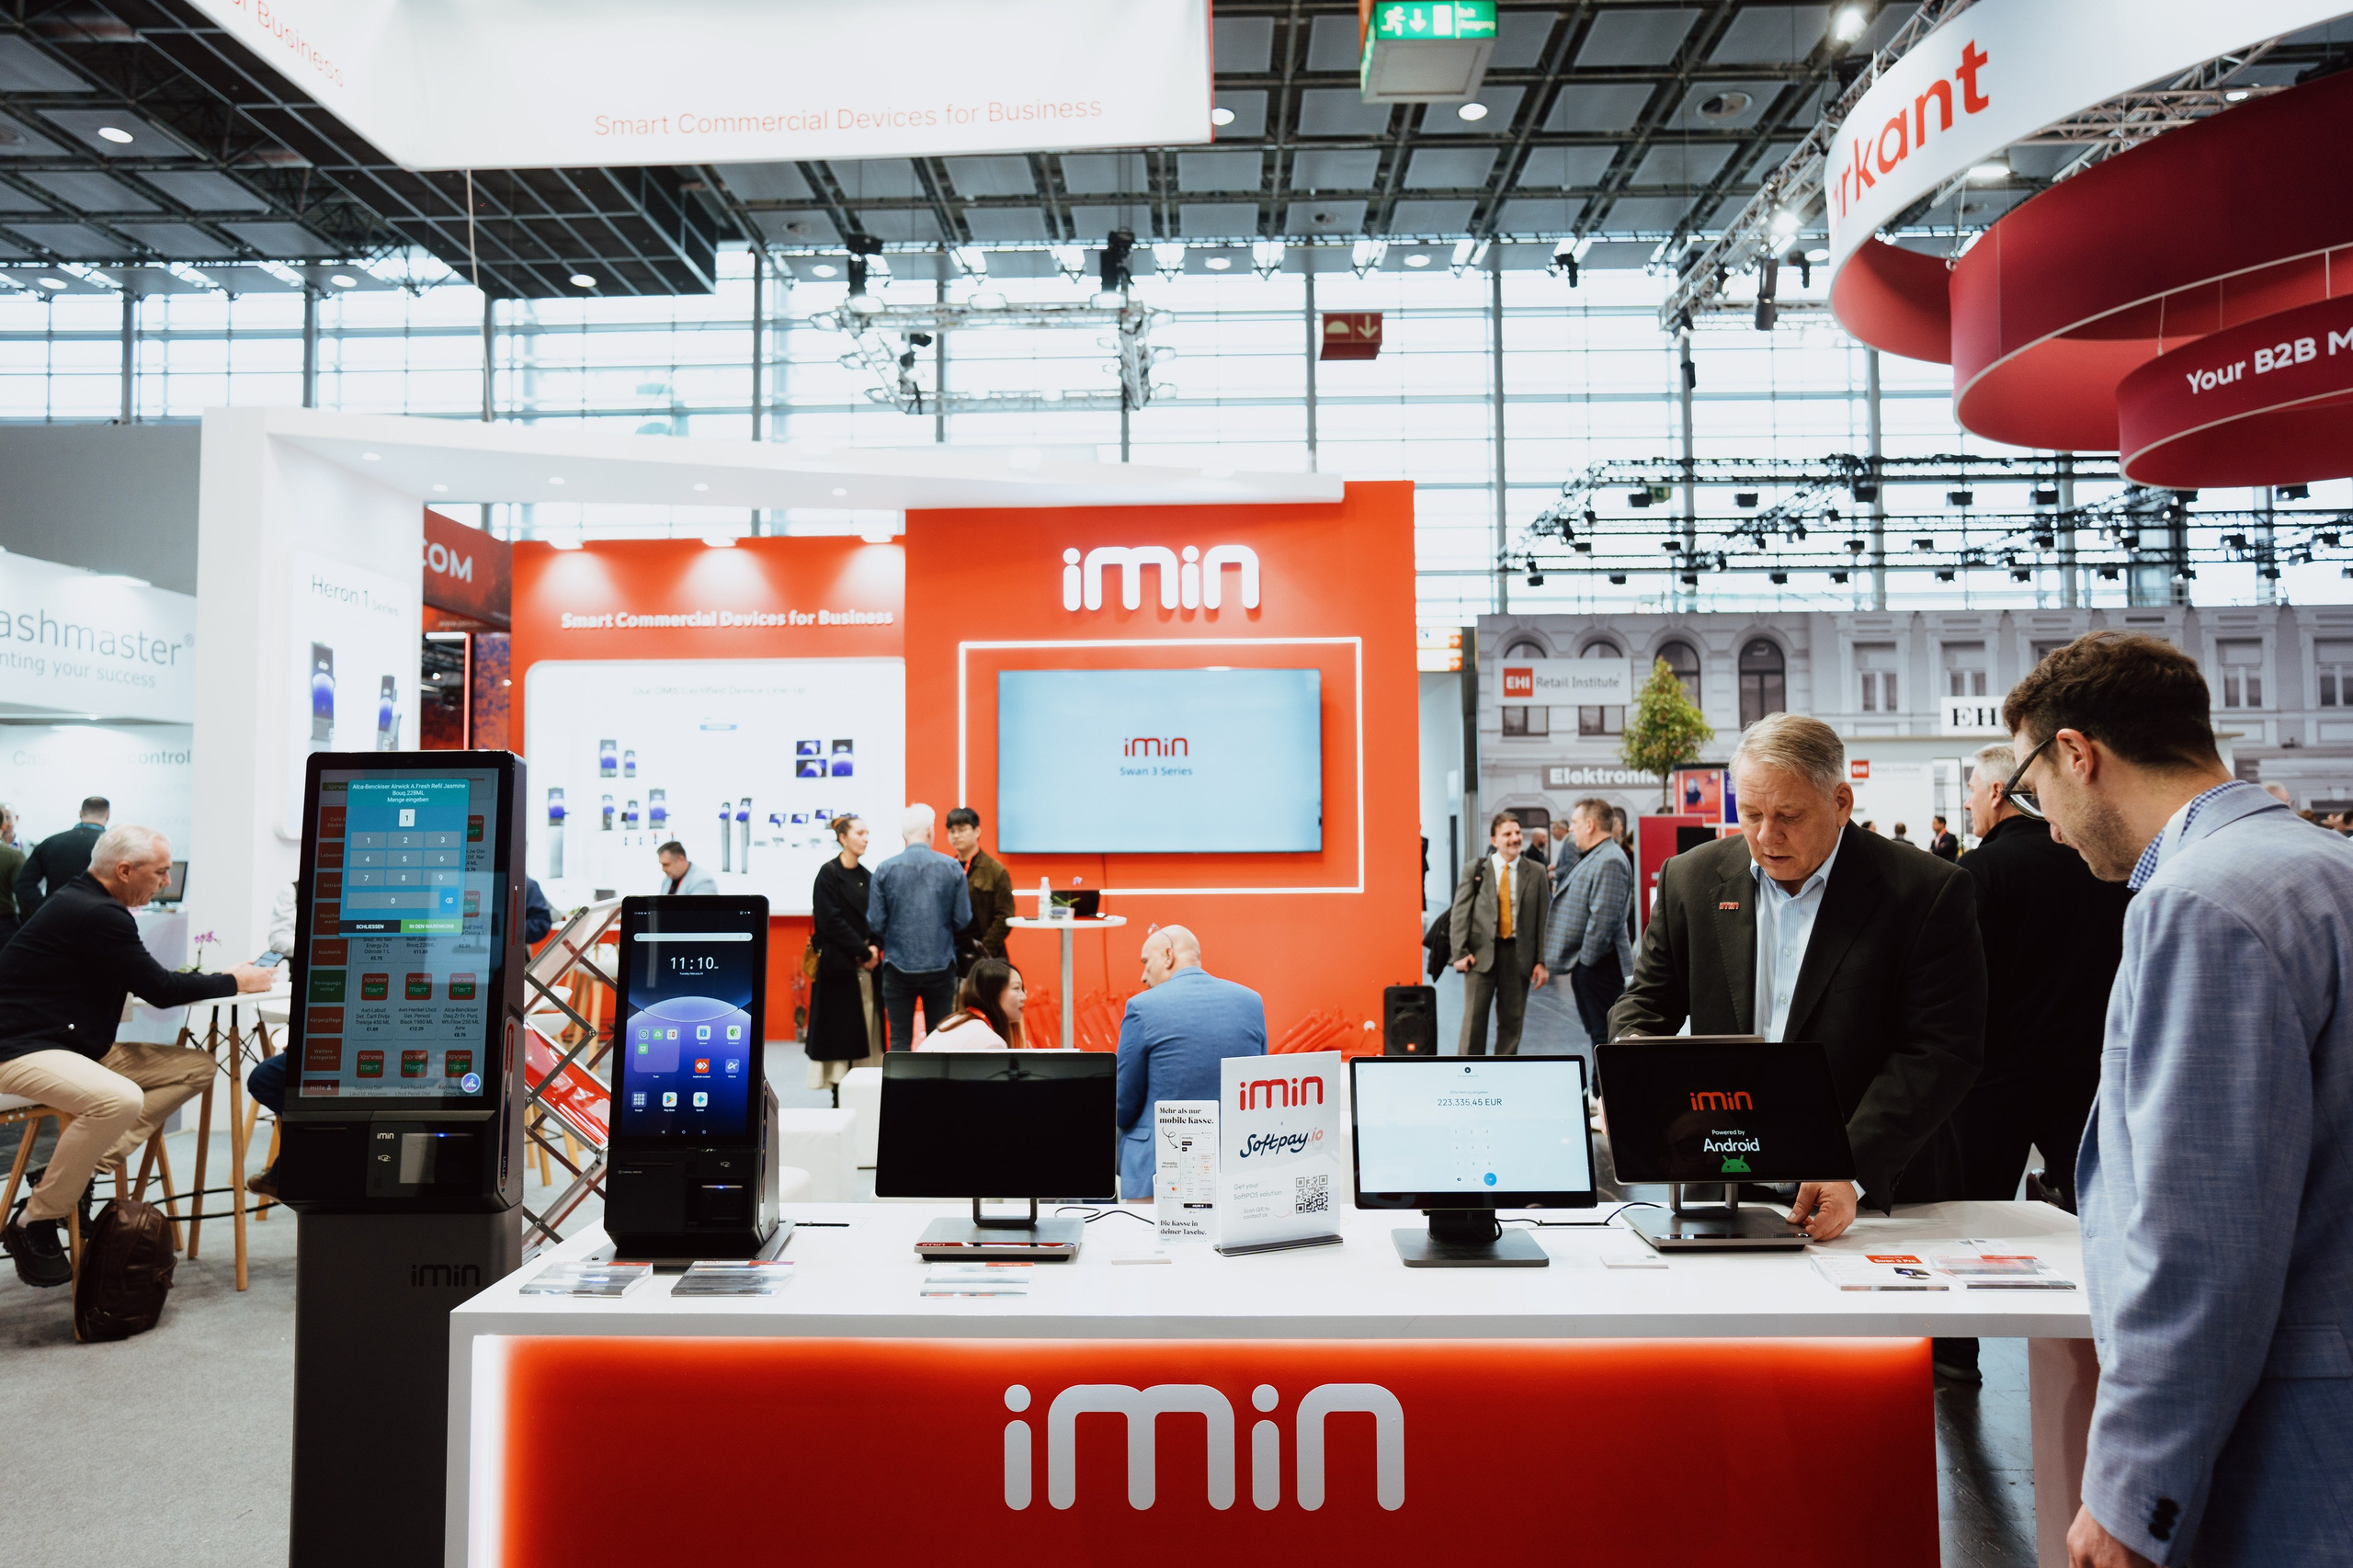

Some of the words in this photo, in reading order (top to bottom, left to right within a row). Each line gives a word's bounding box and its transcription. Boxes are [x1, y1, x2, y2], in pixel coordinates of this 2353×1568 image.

[257, 0, 344, 87] Business
[595, 114, 669, 136] Smart
[677, 110, 829, 134] Commercial
[837, 106, 938, 130] Devices
[946, 103, 981, 124] for
[988, 99, 1103, 122] Business
[2186, 360, 2246, 394] Your
[2254, 336, 2317, 374] B2B
[423, 538, 472, 584] OM
[312, 574, 358, 605] Heron
[363, 590, 369, 608] 1
[1063, 544, 1260, 612] imin
[562, 612, 613, 630] Smart
[616, 610, 717, 629] Commercial
[720, 609, 786, 627] Devices
[789, 609, 815, 626] for
[818, 609, 893, 627] Business
[52, 660, 90, 677] your
[97, 666, 156, 688] success
[1506, 676, 1530, 689] EHI
[1536, 676, 1569, 688] Retail
[1573, 676, 1620, 688] Institute
[1124, 736, 1188, 757] imin
[1120, 767, 1149, 776] Swan
[1152, 767, 1158, 776] 3
[1161, 766, 1193, 777] Series
[1240, 1076, 1324, 1111] imin
[1438, 1098, 1483, 1107] 223.335,45
[1689, 1091, 1754, 1111] imin
[1239, 1127, 1324, 1158] Softpay.io
[1703, 1138, 1760, 1152] Android
[1233, 1192, 1258, 1200] SoftPOS
[411, 1264, 481, 1287] imin
[1004, 1383, 1405, 1512] imin
